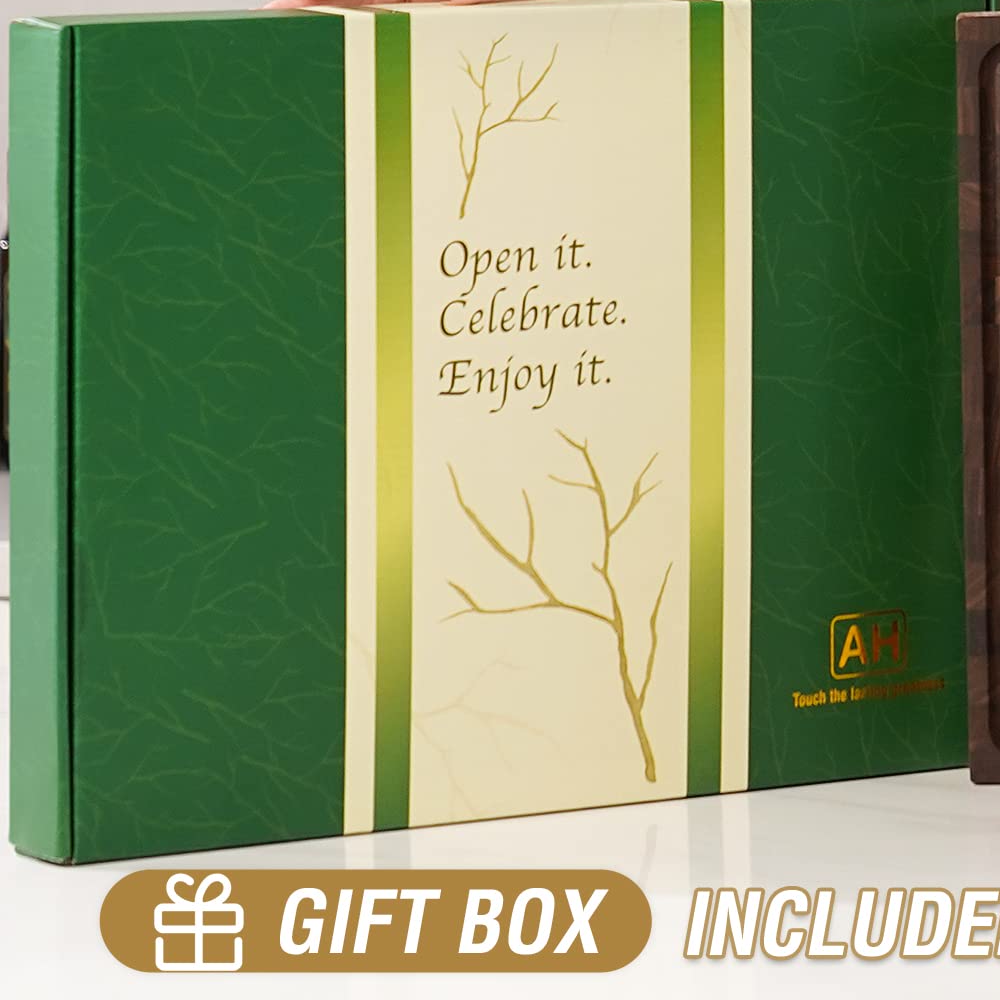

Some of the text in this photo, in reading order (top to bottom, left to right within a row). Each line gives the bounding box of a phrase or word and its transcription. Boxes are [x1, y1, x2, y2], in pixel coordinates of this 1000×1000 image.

[440, 233, 592, 297] Open it.
[440, 284, 626, 337] Celebrate.
[437, 350, 611, 413] Enjoy it.
[837, 620, 899, 668] AH
[792, 689, 826, 708] Touch
[829, 687, 847, 703] the
